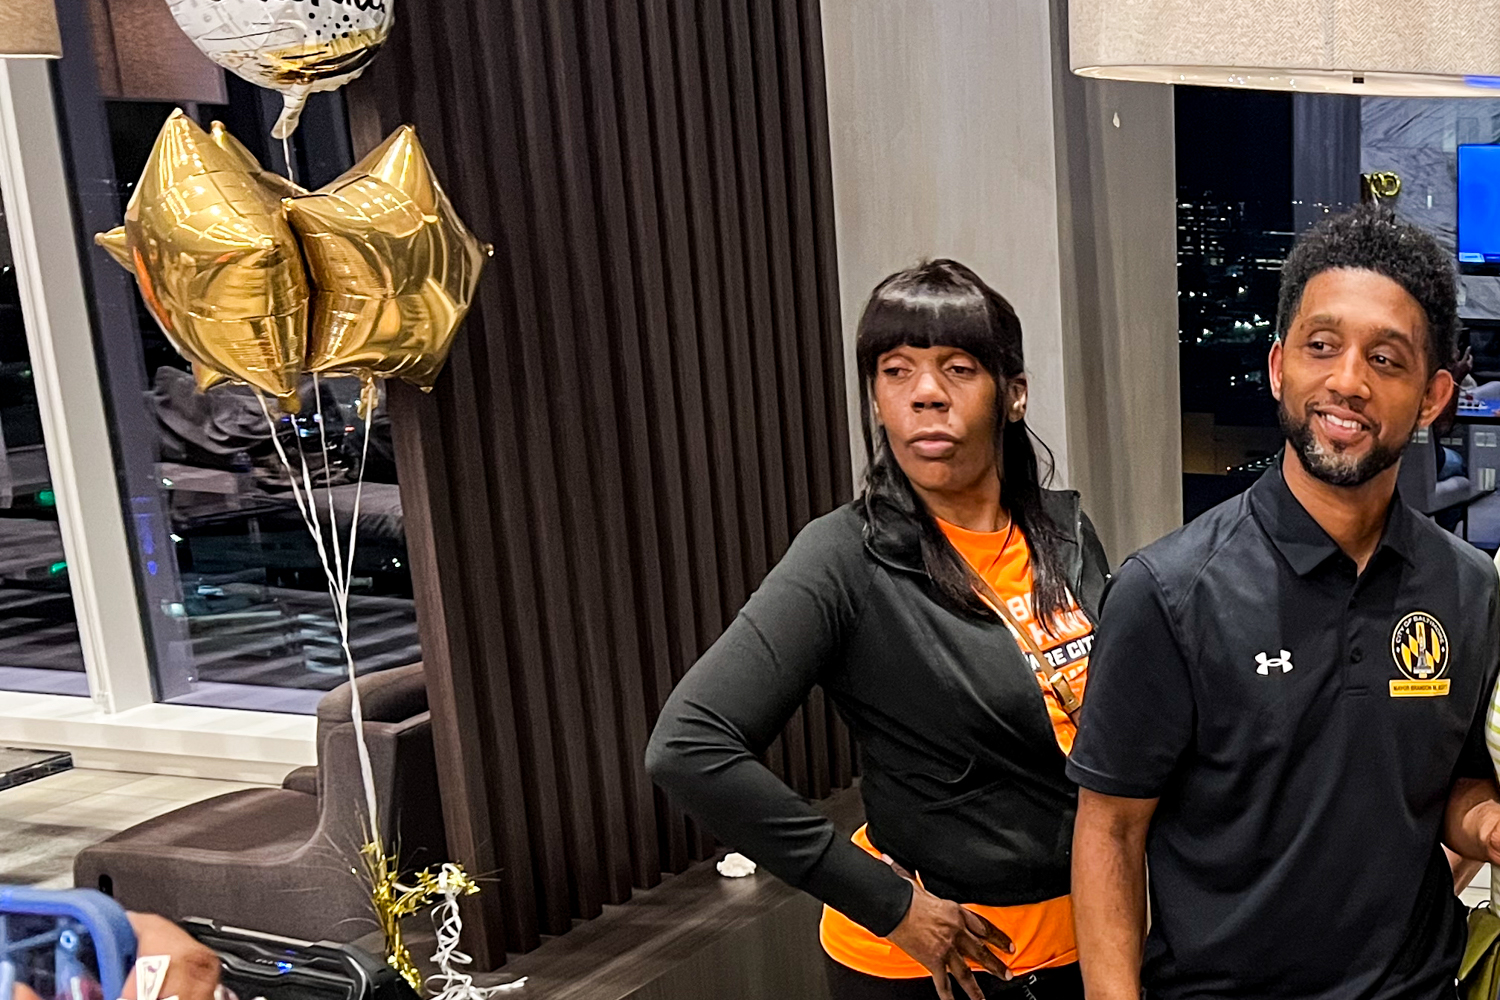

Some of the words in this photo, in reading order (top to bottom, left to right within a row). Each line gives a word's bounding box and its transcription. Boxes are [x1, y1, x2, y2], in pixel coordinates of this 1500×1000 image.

[1395, 625, 1405, 643] CITY
[1403, 617, 1412, 628] OF
[1413, 615, 1445, 645] BALTIMORE
